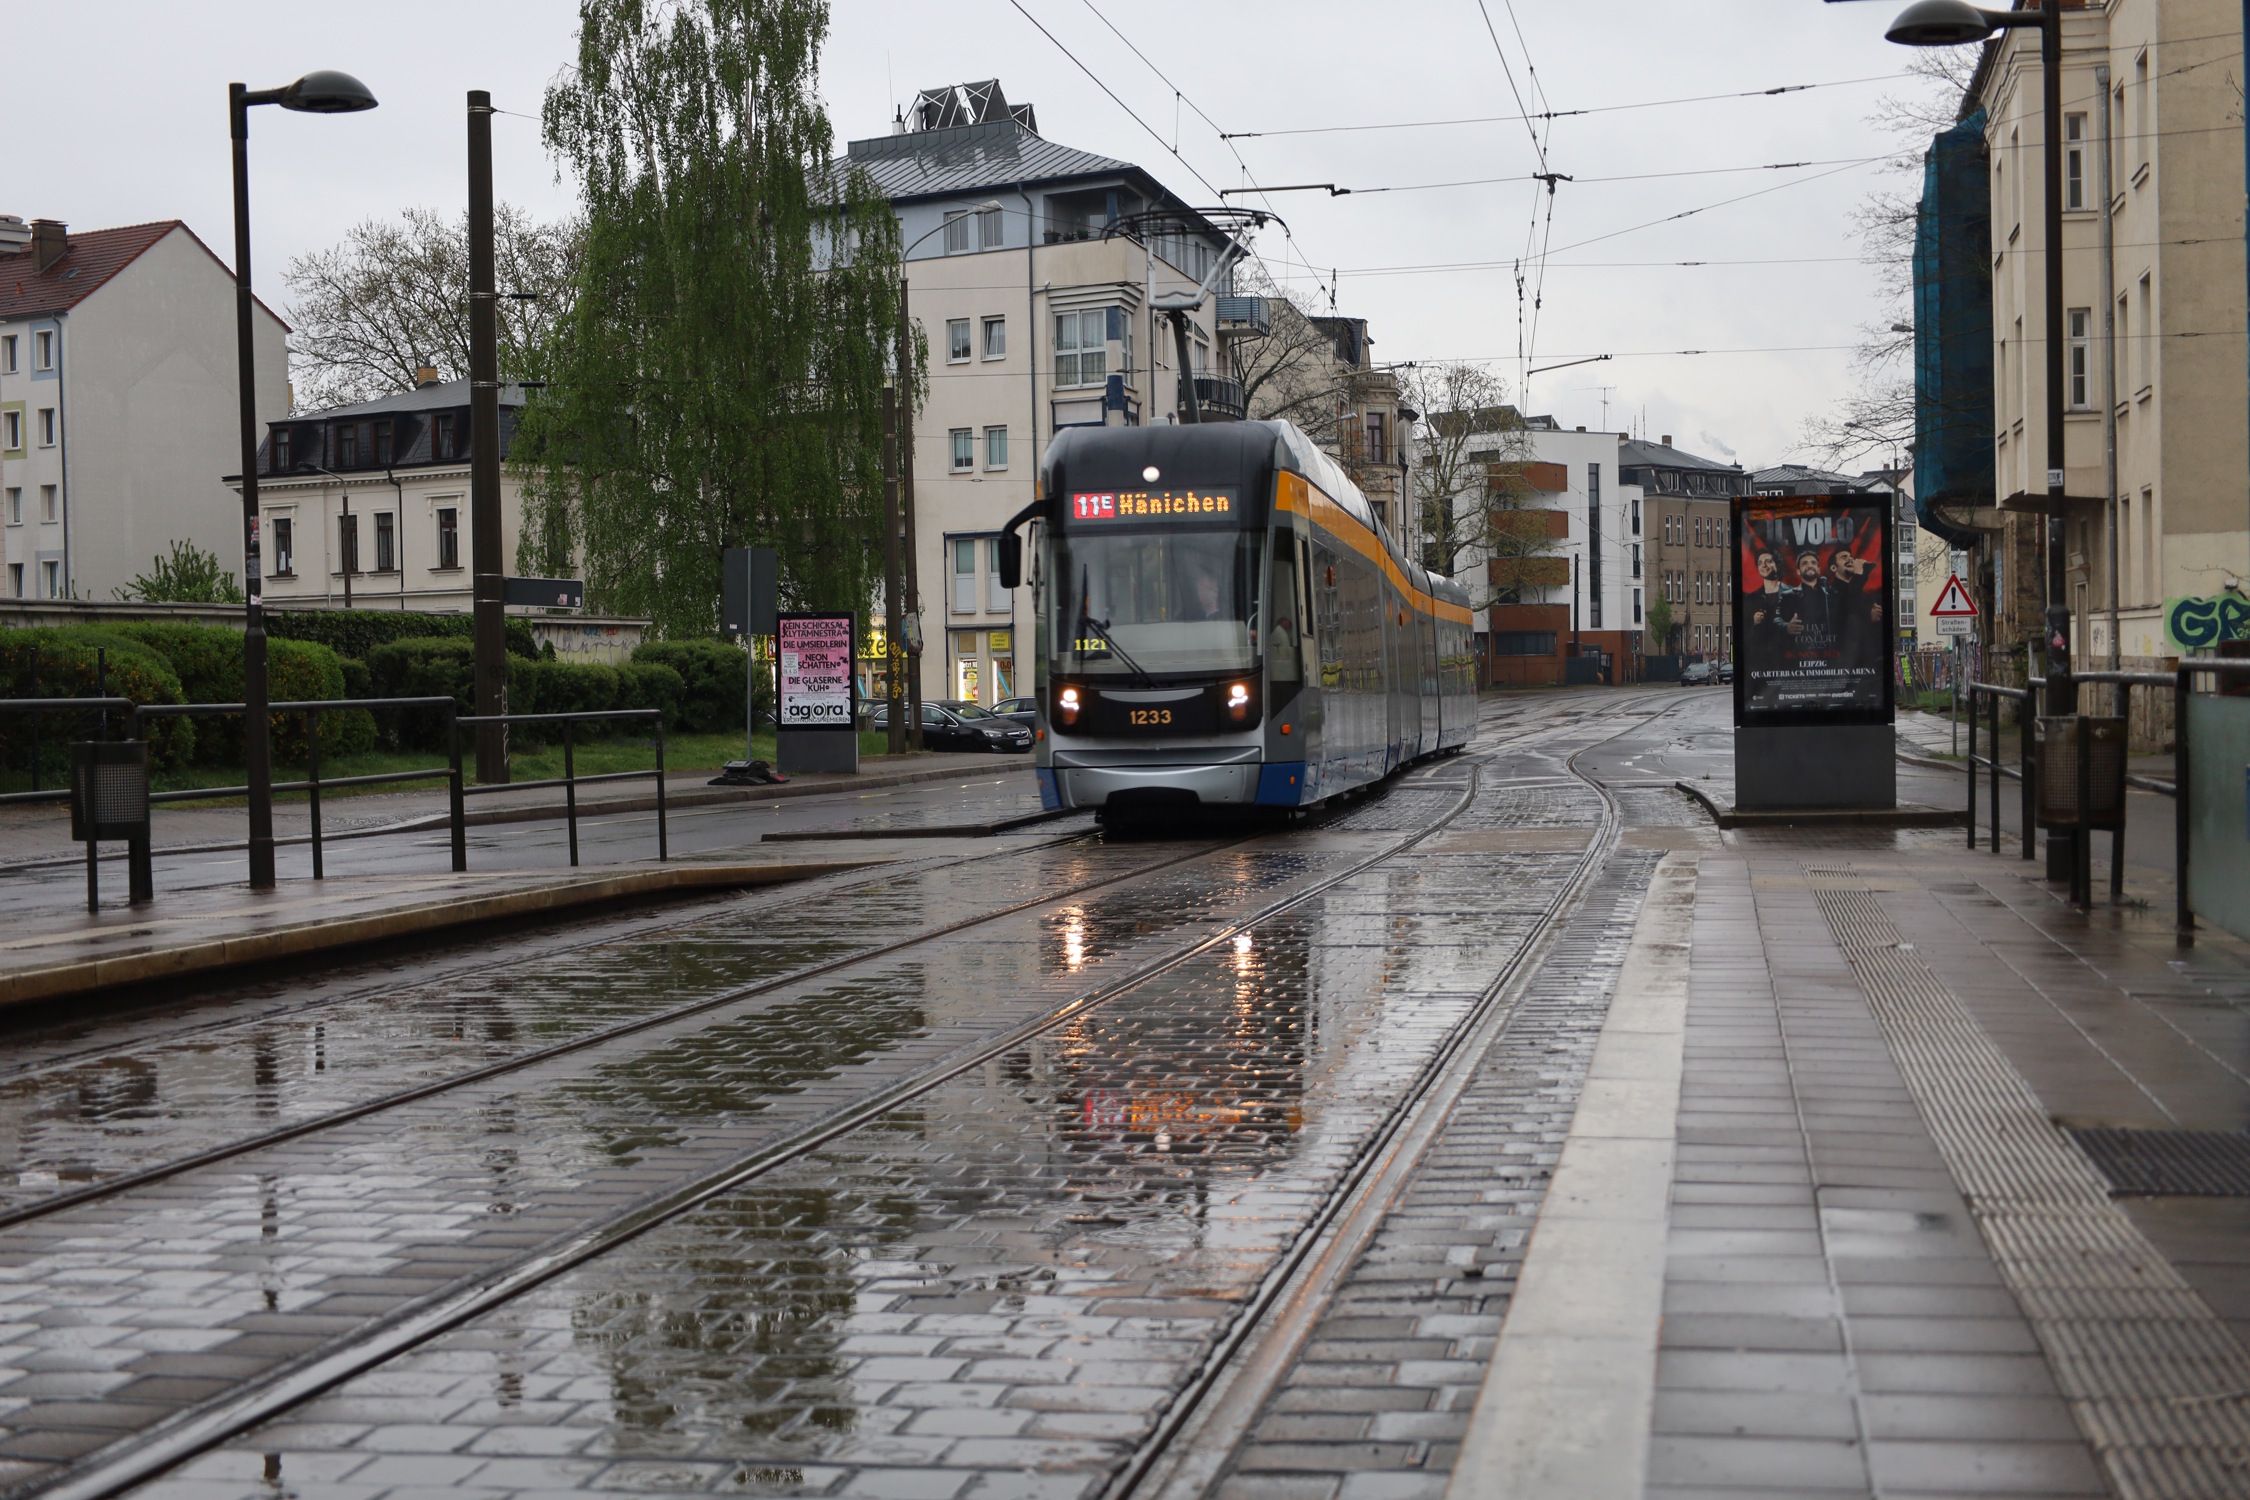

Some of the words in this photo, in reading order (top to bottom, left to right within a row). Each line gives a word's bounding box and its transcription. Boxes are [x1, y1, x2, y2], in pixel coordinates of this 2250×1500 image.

[1077, 495, 1113, 516] 11E
[1119, 491, 1230, 515] Hänichen
[1766, 519, 1789, 546] IL
[1792, 517, 1854, 546] VOLO
[1806, 623, 1825, 632] LIVE
[783, 629, 842, 637] KLYTÄMNESTRA
[1794, 634, 1838, 643] CONCERT
[796, 640, 847, 648] UMSIEDLERIN
[1074, 638, 1108, 651] 1121
[805, 653, 828, 661] NEON
[798, 661, 836, 669] SCHATTEN
[1799, 660, 1827, 668] LEIPZIG
[1750, 669, 1805, 679] QUARTERBACK
[1806, 668, 1850, 677] IMMOBILIEN
[1850, 667, 1876, 676] ARENA
[788, 676, 800, 685] DIE
[802, 676, 843, 685] GLÄSERNE
[1831, 691, 1854, 699] eventim
[789, 702, 844, 720] ag(o)ra
[783, 716, 850, 724] ERÖFFNUNGSPREMIEREN
[1130, 709, 1172, 725] 1233
